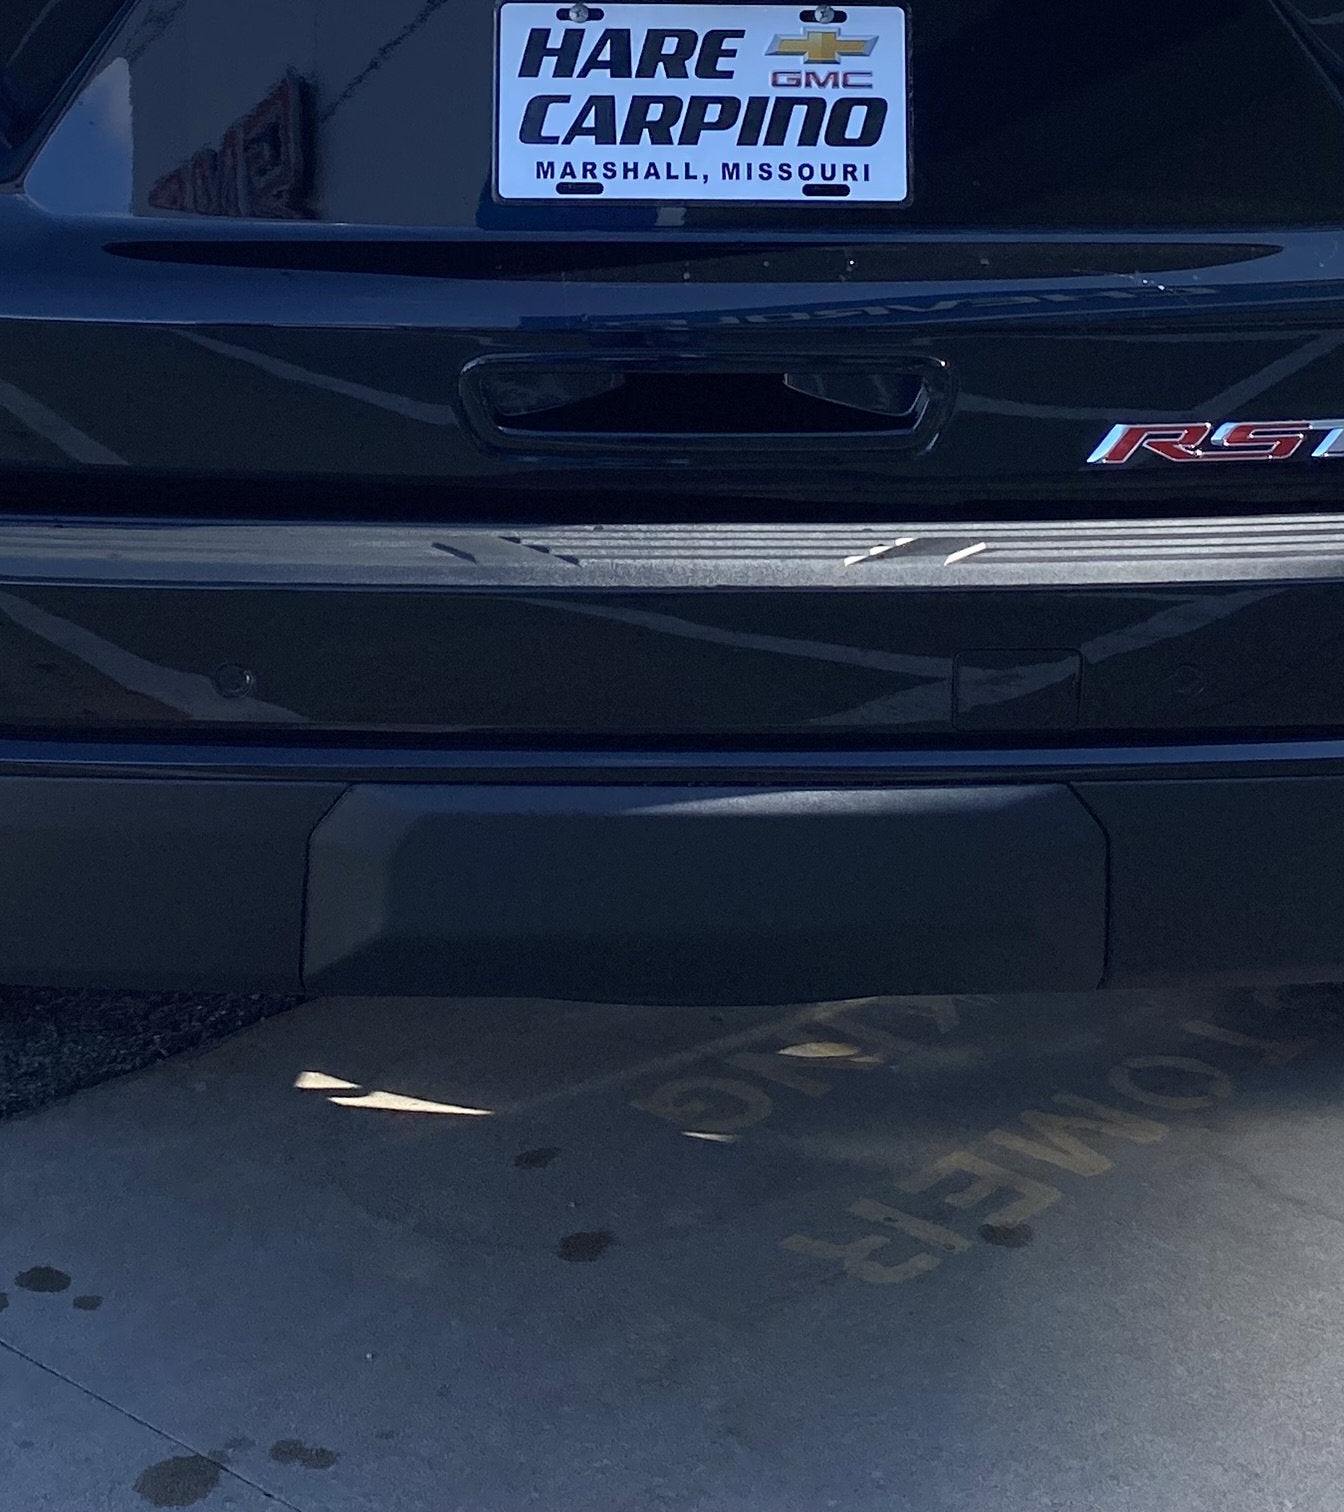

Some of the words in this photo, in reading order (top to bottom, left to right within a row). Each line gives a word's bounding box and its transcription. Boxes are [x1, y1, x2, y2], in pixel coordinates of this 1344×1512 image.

[517, 27, 746, 80] HARE
[770, 69, 874, 90] GMC
[518, 94, 889, 148] CARPINO
[535, 161, 710, 185] MARSHALL,
[720, 161, 872, 183] MISSOURI
